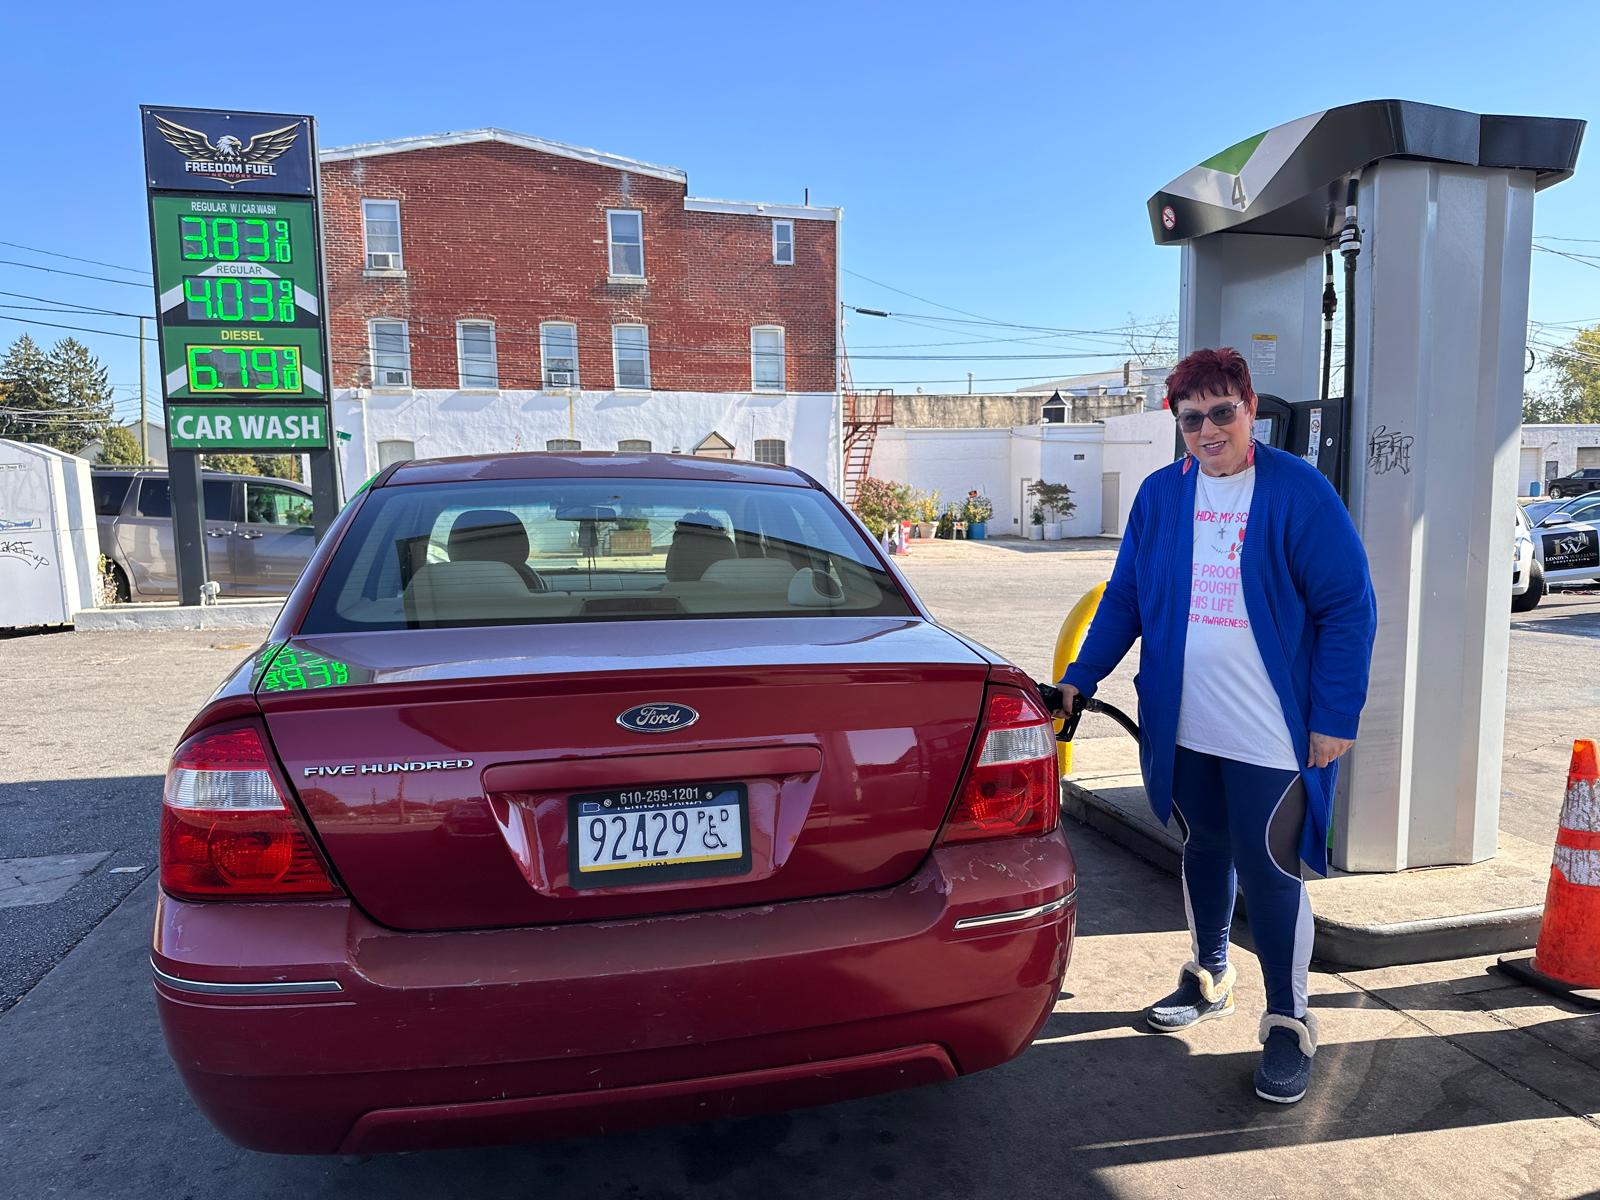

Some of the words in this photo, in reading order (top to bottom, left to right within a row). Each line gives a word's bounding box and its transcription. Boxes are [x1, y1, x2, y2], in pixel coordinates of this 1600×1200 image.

[185, 161, 242, 173] FREEDOM
[245, 164, 278, 176] FUEL
[1231, 176, 1247, 210] 4
[191, 201, 228, 212] REGULAR
[216, 264, 262, 275] REGULAR
[221, 330, 264, 341] DIESEL
[177, 415, 233, 440] CAR
[238, 415, 320, 440] WASH
[1195, 510, 1217, 523] HIDE
[1219, 512, 1234, 524] MY
[1235, 512, 1249, 524] SC
[1193, 579, 1239, 596] FOUGHT
[1190, 594, 1208, 610] HIS
[1211, 597, 1234, 613] LIFE
[1202, 615, 1249, 629] AWARENESS
[636, 706, 680, 725] Ford
[304, 765, 356, 776] FIVE
[361, 759, 474, 775] HUNDRED
[620, 787, 699, 805] 610-259-1201
[589, 811, 689, 862] 92429
